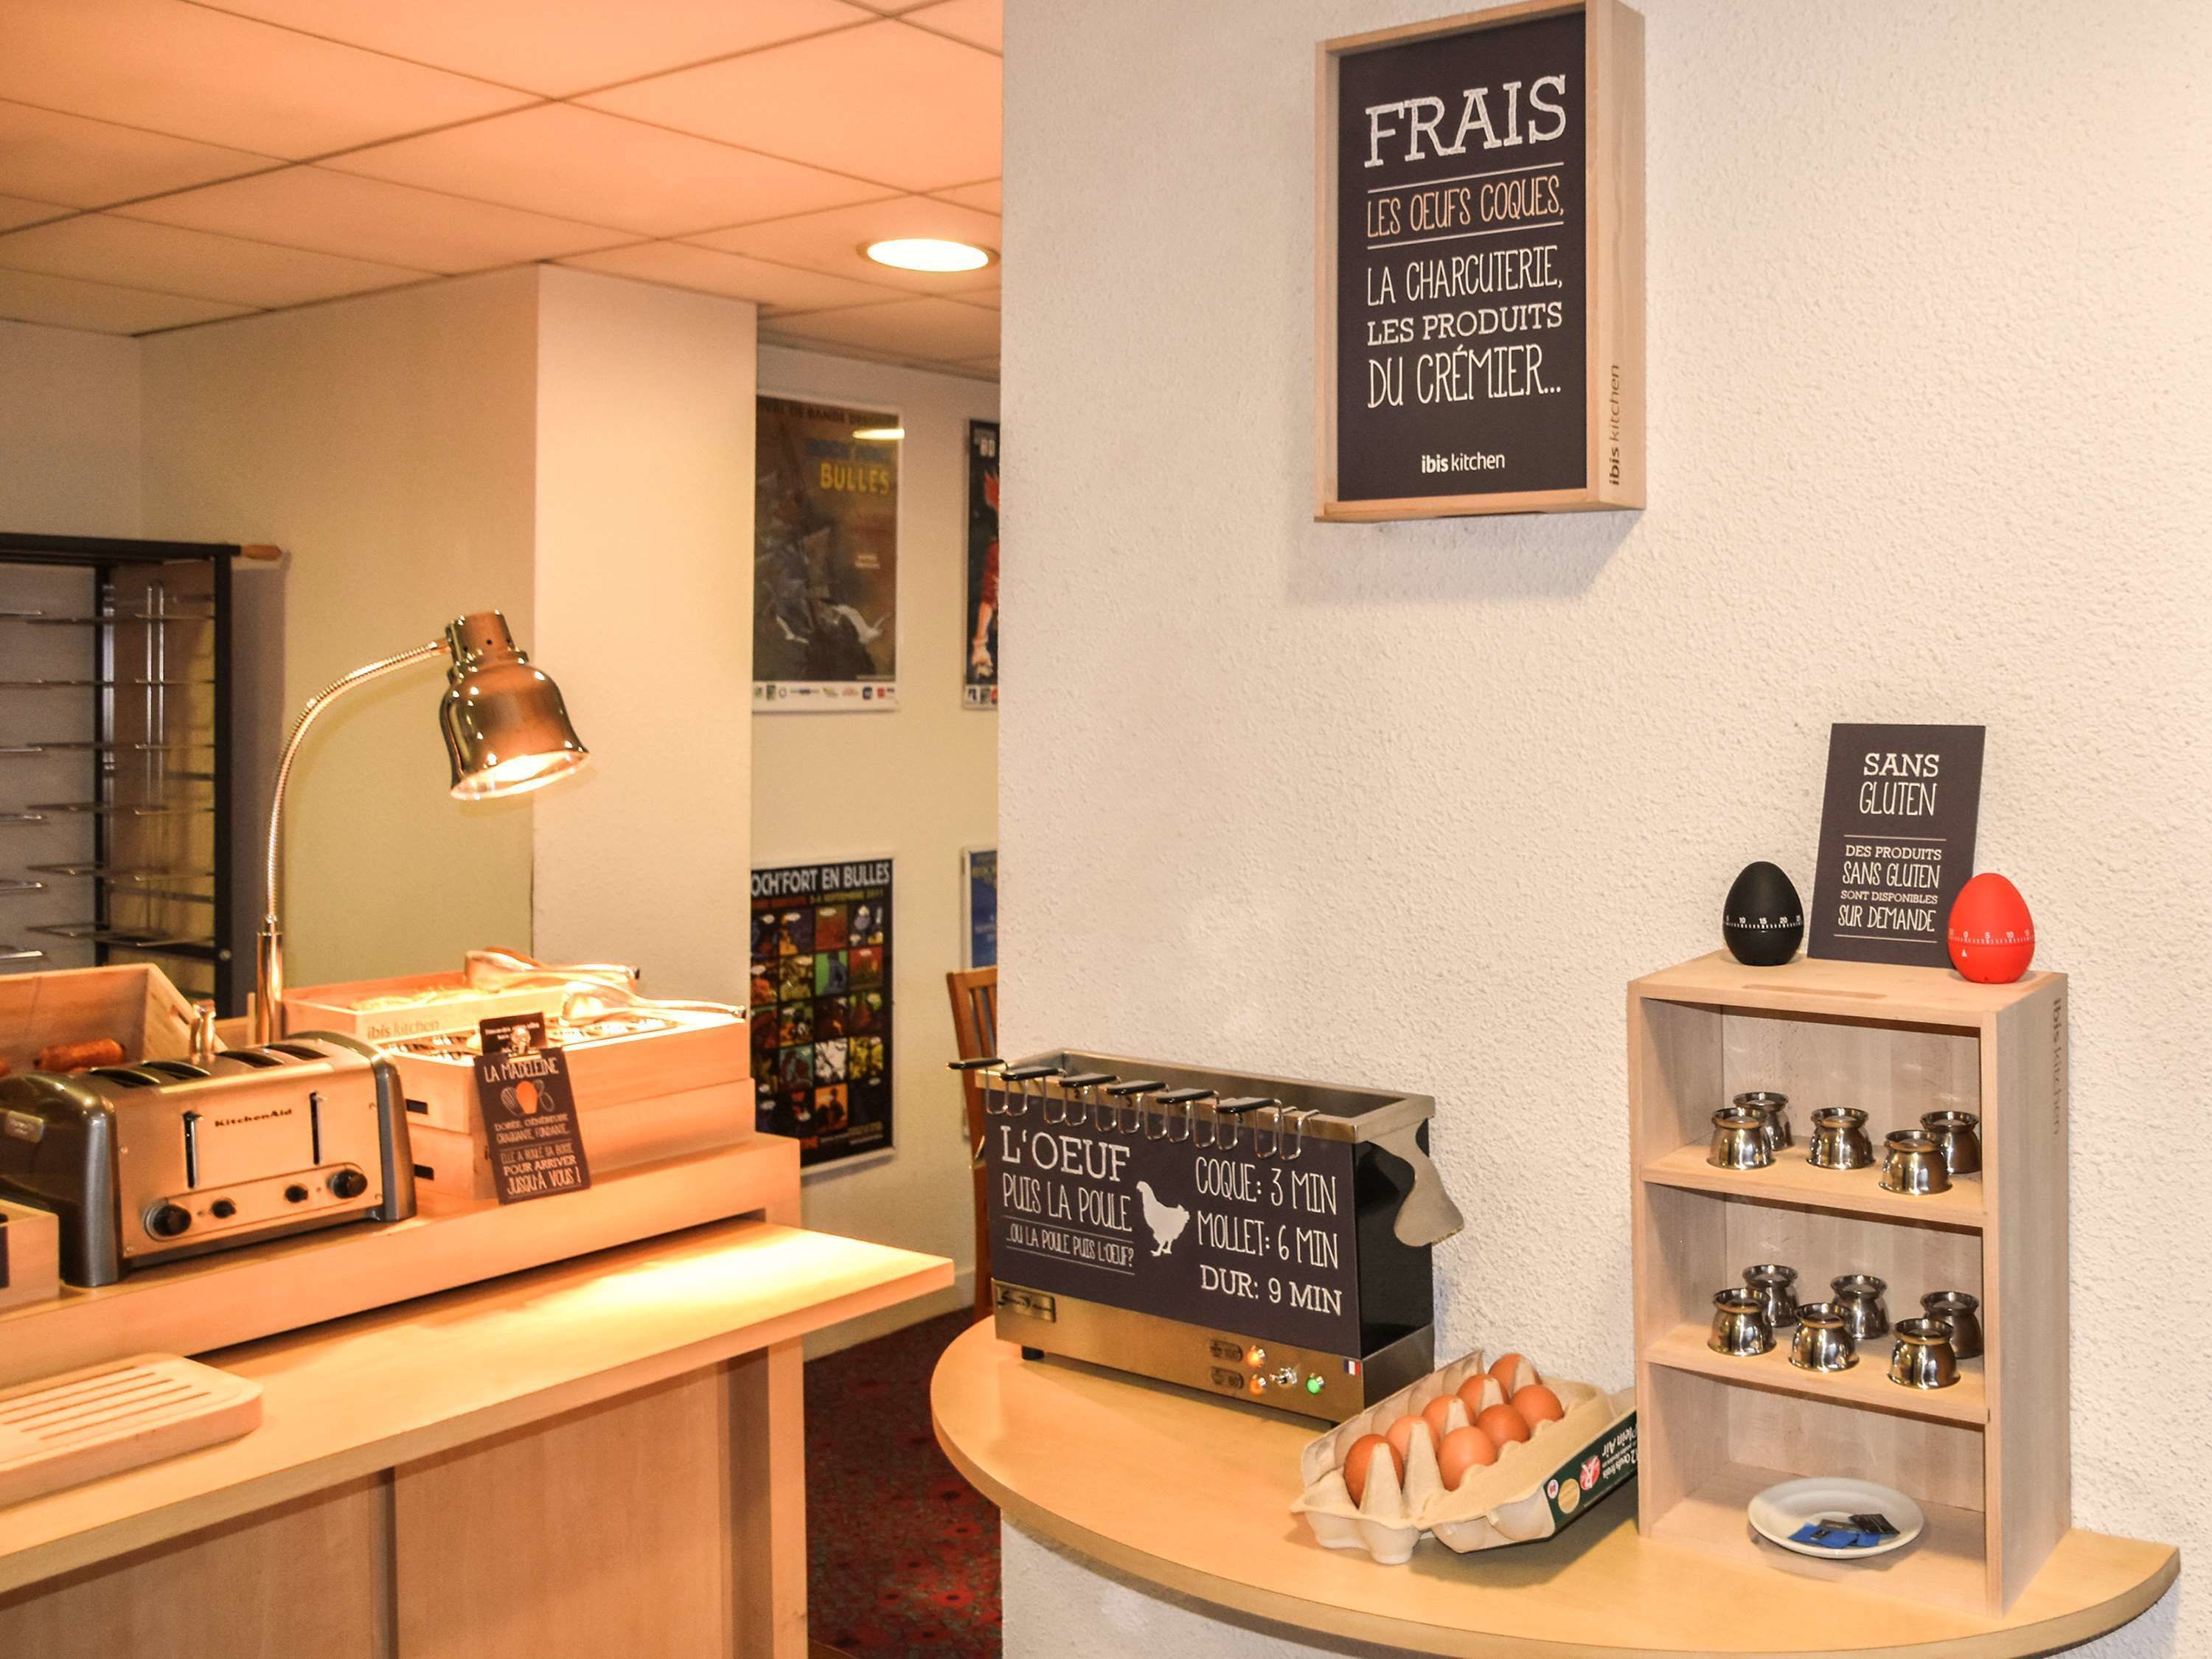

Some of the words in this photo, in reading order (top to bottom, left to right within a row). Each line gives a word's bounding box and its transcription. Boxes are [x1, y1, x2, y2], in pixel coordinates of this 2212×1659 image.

[1364, 74, 1567, 168] FRAIS
[1367, 197, 1401, 237] LES
[1410, 187, 1471, 232] OEUFS
[1481, 175, 1564, 222] COQUES,
[1367, 266, 1397, 306] LA
[1406, 245, 1562, 302] CHARCUTERIE,
[1367, 317, 1414, 346] LES
[1422, 302, 1562, 341] PRODUITS
[1368, 356, 1404, 408] DU
[1416, 344, 1562, 404] CRÉMIER...
[1609, 364, 1620, 442] kitchen
[820, 461, 890, 495] BULLES
[1421, 454, 1449, 473] ibis
[1451, 451, 1505, 471] kitchen
[1609, 446, 1620, 486] ibis
[1863, 753, 1939, 777] SANS
[1859, 781, 1938, 816] GLUTEN
[1845, 845, 1871, 857] DES
[1875, 846, 1942, 860] PRODUITS
[751, 870, 818, 897] OCH'FORT
[821, 867, 840, 890] EN
[844, 862, 889, 888] BULLES
[1843, 860, 1882, 886] SANS
[1886, 863, 1941, 888] GLUTEN
[1840, 890, 1870, 900] SONT
[1871, 891, 1938, 904] DISPONIBLES
[1779, 916, 1789, 924] 20
[1838, 905, 1863, 928] SUR
[1867, 906, 1937, 932] DEMANDE
[1984, 931, 1991, 939] 5
[2006, 931, 2015, 939] 10
[484, 1065, 500, 1082] LA
[501, 1057, 559, 1079] MADELEINE
[215, 1108, 292, 1127] KitchenAid
[503, 1162, 532, 1176] POUR
[535, 1154, 577, 1172] ARRIVER
[1000, 1125, 1130, 1182] L'OEUF
[548, 1167, 574, 1187] VOUS
[1195, 1156, 1262, 1202] COQUE:
[1271, 1168, 1284, 1206] 3
[1291, 1170, 1337, 1215] MIN
[1003, 1172, 1042, 1214] PUIS
[1047, 1181, 1072, 1221] LA
[1078, 1186, 1133, 1232] POULE
[1026, 1226, 1040, 1248] LA
[1042, 1229, 1071, 1254] POULE
[1073, 1236, 1096, 1262] PUIS
[1197, 1210, 1270, 1256] MOLLET:
[1278, 1225, 1290, 1261] 6
[1296, 1226, 1339, 1270] MIN
[1200, 1264, 1259, 1300] DUR:
[1268, 1277, 1281, 1304] 9
[1289, 1281, 1343, 1316] MIN
